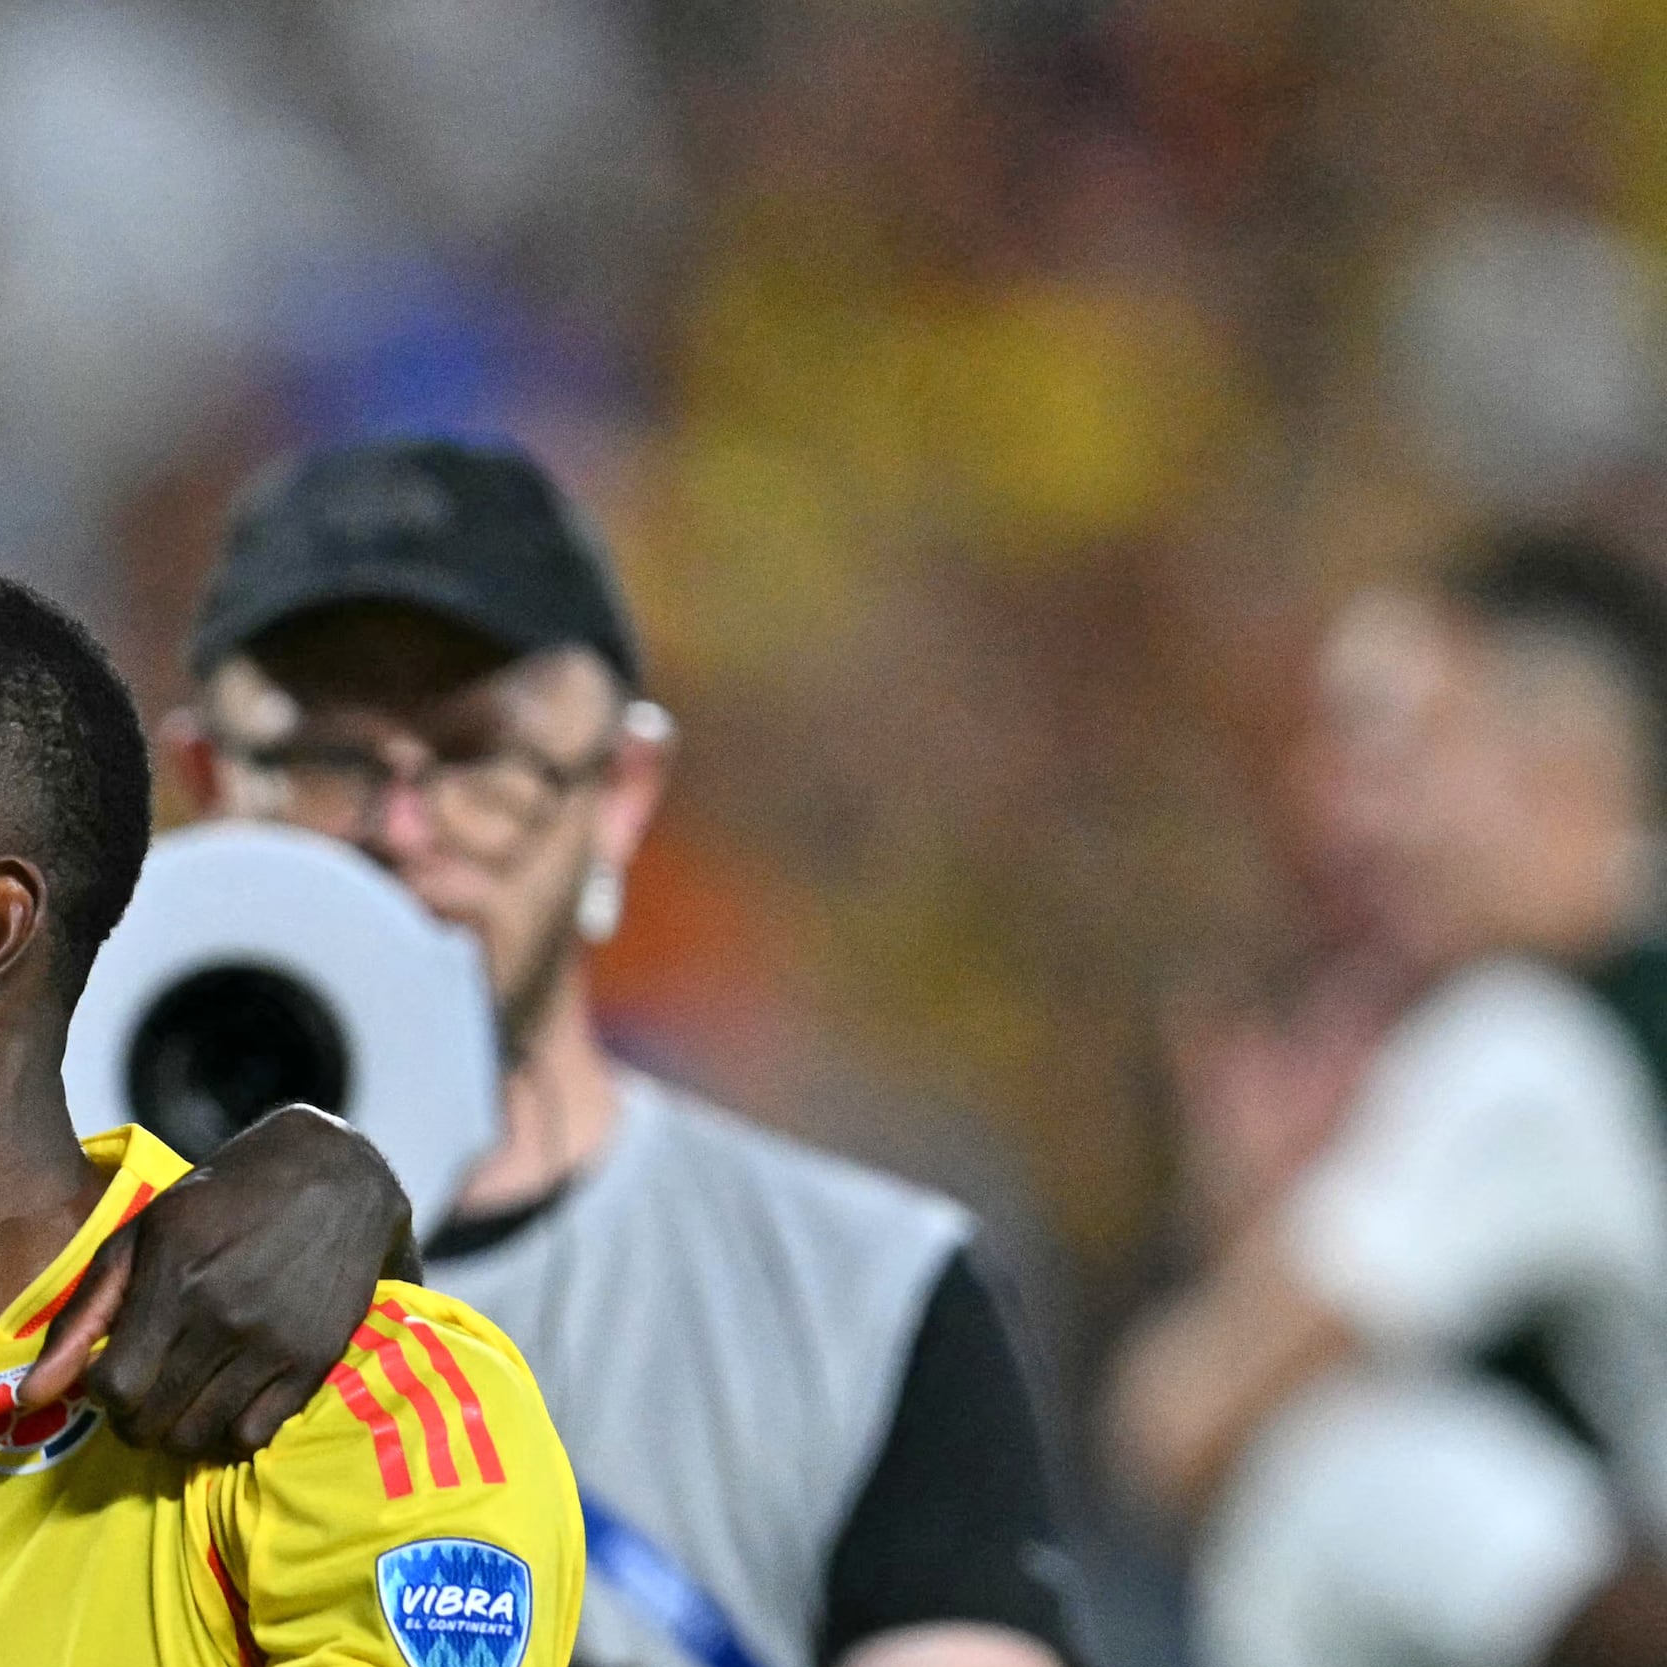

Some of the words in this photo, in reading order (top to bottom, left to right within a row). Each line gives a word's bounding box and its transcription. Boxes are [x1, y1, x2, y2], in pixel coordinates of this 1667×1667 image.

[402, 1585, 514, 1622] VIBRA
[404, 1617, 424, 1630] EL
[427, 1618, 514, 1637] CONTINENTE
